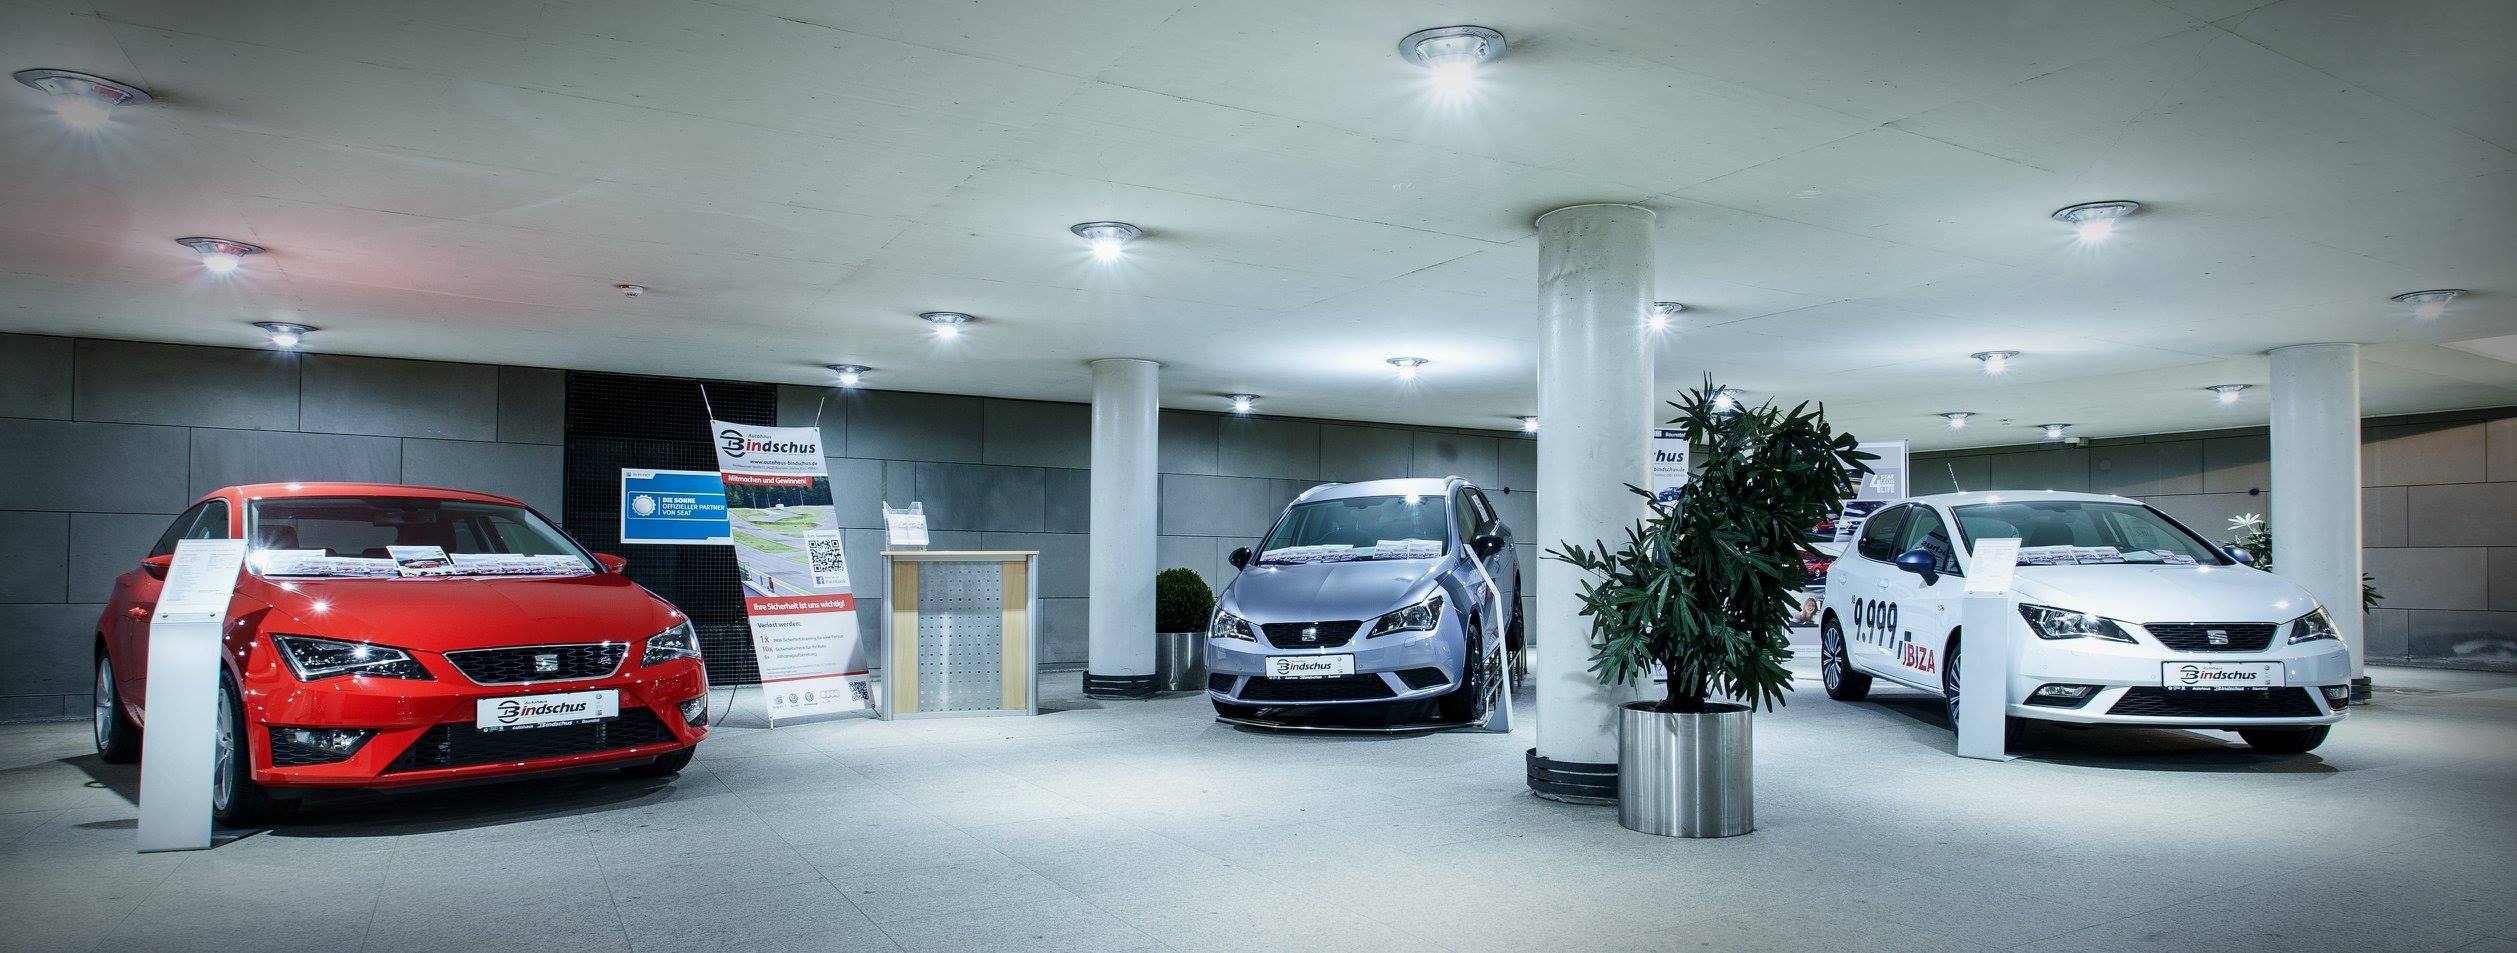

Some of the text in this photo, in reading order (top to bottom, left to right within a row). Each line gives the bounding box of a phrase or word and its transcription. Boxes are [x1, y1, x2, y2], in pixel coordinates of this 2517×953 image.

[720, 429, 816, 458] Bindschus
[1653, 450, 1684, 462] hus
[728, 474, 762, 483] Mitmachen
[775, 477, 807, 485] Gewinnen!
[753, 603, 767, 611] Ihre
[767, 602, 799, 610] Sicherheit
[821, 600, 846, 609] wichtig!
[760, 635, 770, 643] 1x
[1903, 643, 1936, 674] IBIZA
[1277, 659, 1332, 675] Bindschus
[2180, 665, 2257, 684] Bindschus
[497, 700, 587, 724] Bindschus
